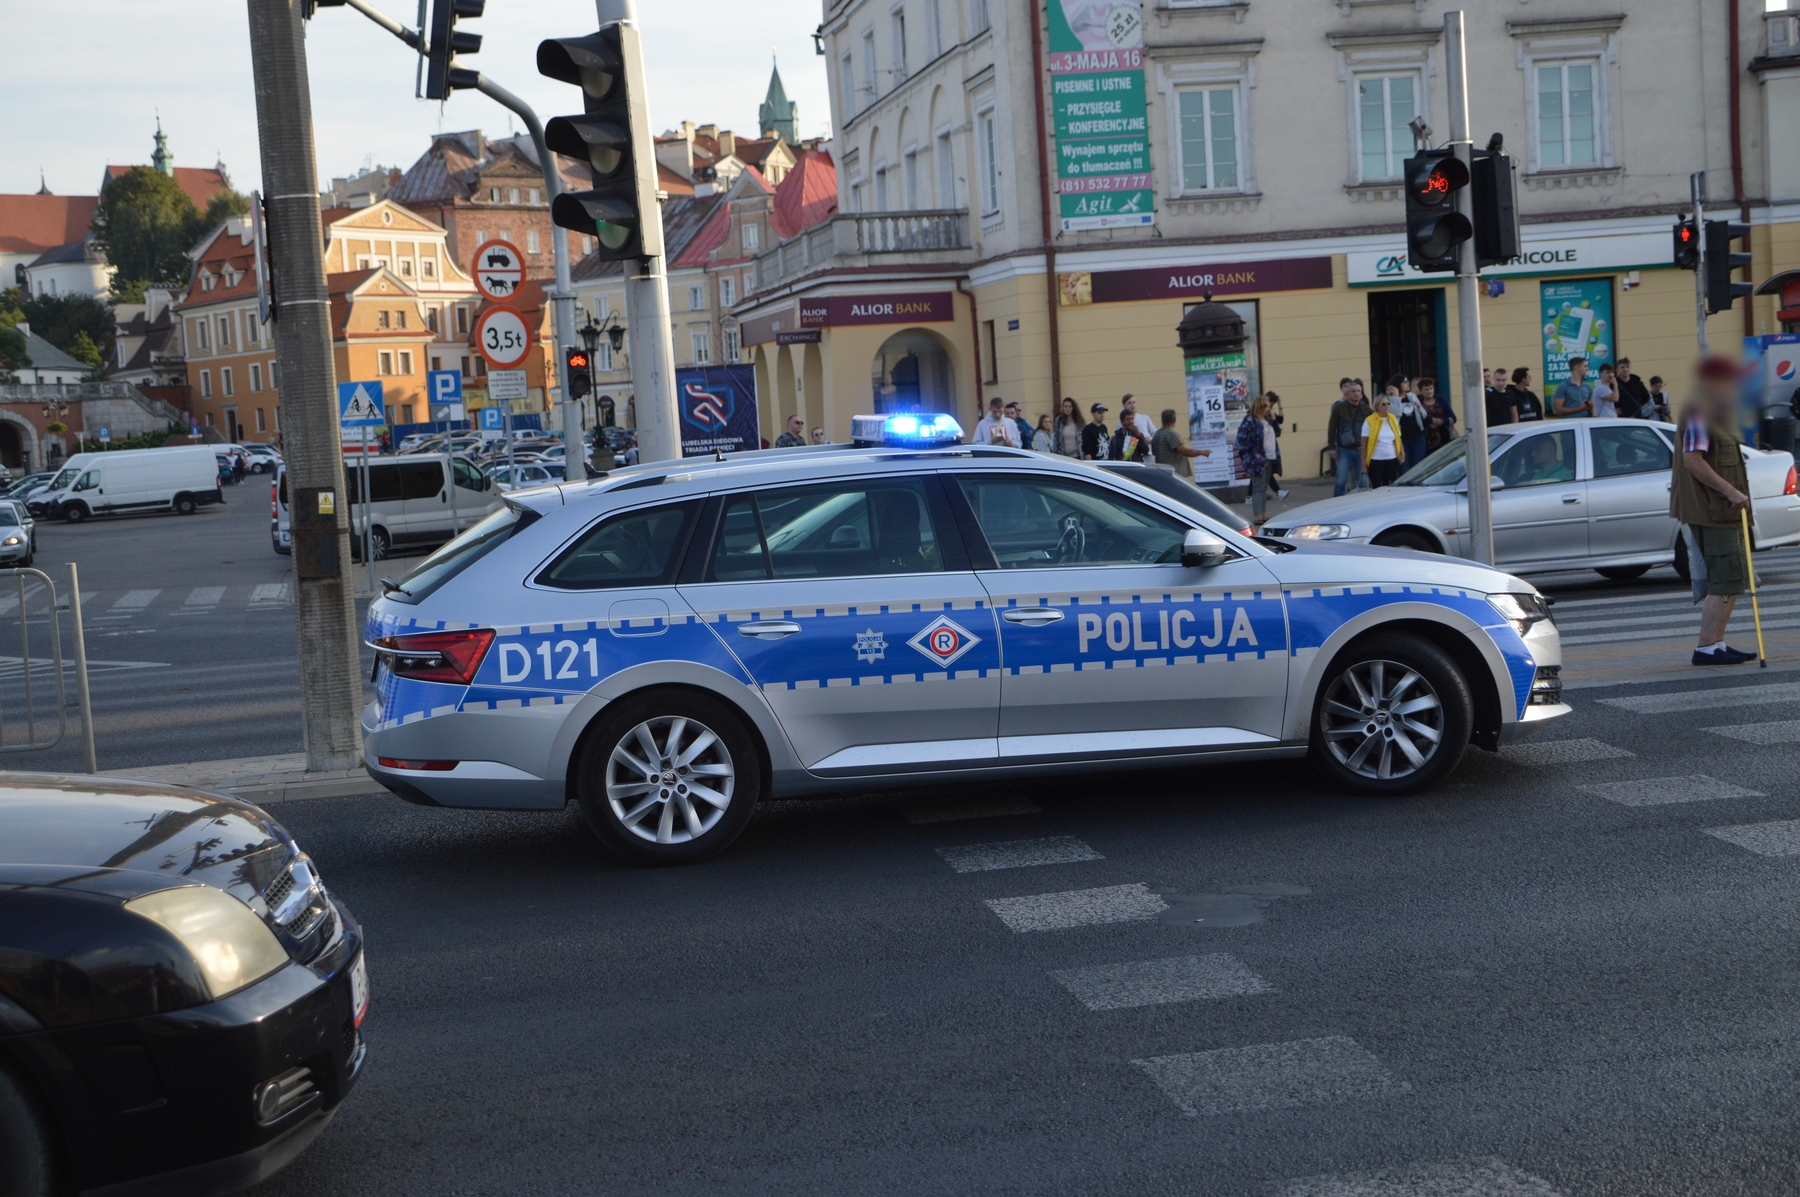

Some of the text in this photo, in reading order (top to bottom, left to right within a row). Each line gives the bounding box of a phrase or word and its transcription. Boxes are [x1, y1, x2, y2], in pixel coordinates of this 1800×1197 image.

[1110, 23, 1125, 38] 25
[1050, 49, 1142, 71] ul. 3-MAJA 16
[1055, 79, 1095, 94] PISEMNE
[1101, 76, 1132, 91] USTNE
[1067, 100, 1122, 117] PRZYSIĘGŁE
[1068, 117, 1146, 134] KONFERENCYJNE
[1062, 141, 1144, 159] Wynajem sprzętu
[1067, 162, 1080, 174] do
[1082, 157, 1132, 173] tłumaczeń
[1061, 175, 1147, 192] (81) 532 77 77
[1074, 195, 1114, 215] Agit
[1168, 271, 1255, 288] ALIOR BANK
[802, 308, 827, 317] ALIOR
[851, 302, 932, 316] ALIOR BANK
[780, 333, 818, 342] EXCHANGE
[1191, 360, 1239, 371] NAKLEJANIA
[1205, 398, 1221, 411] 16
[682, 439, 713, 447] LUBELSKA
[1079, 607, 1258, 653] POLICJA
[938, 634, 950, 648] R
